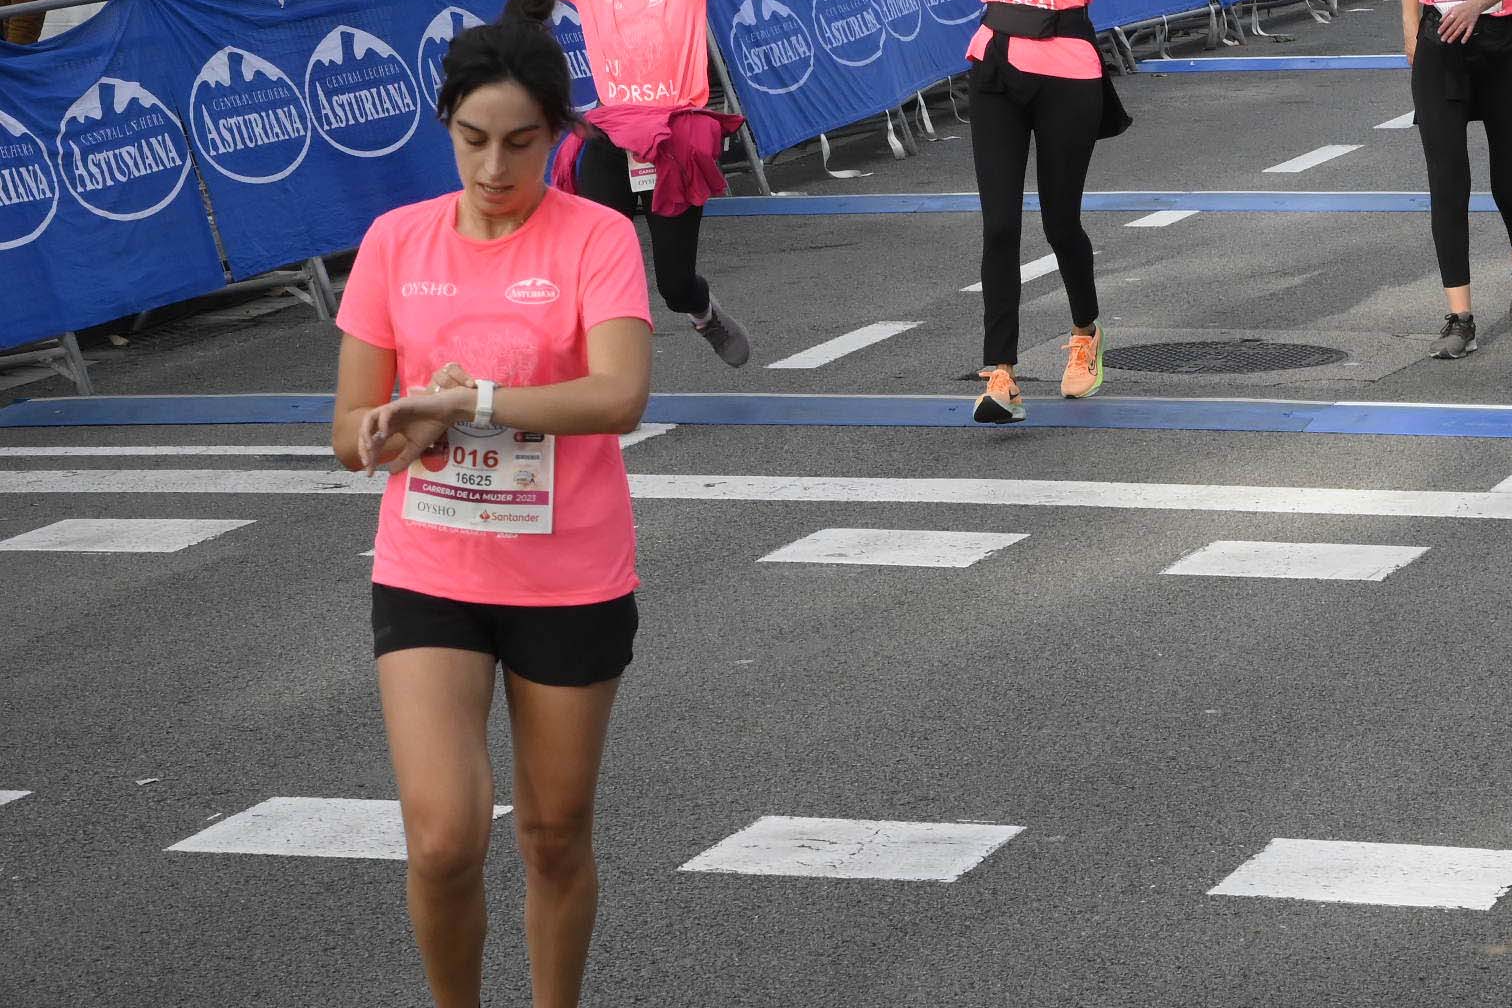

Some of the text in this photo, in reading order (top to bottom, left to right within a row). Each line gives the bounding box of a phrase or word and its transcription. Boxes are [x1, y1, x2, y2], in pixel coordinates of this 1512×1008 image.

[562, 31, 584, 44] LECHE
[820, 7, 881, 49] ASTURIN
[326, 63, 400, 90] CENTRAL LECHERA
[213, 86, 290, 112] CENTRAL LECHERA
[608, 79, 678, 103] DORSAL
[316, 80, 416, 131] ASTURIANA
[202, 102, 306, 156] ASTURIANA
[0, 144, 34, 159] ECHERA
[0, 163, 52, 206] RIANA
[637, 178, 655, 186] OYS
[401, 280, 457, 298] OYSHO
[453, 446, 499, 468] 016
[456, 472, 492, 486] 16625
[422, 483, 537, 502] CARRERA DE LA MUJER 2023
[417, 501, 456, 518] OYSHO
[491, 512, 540, 523] Santander
